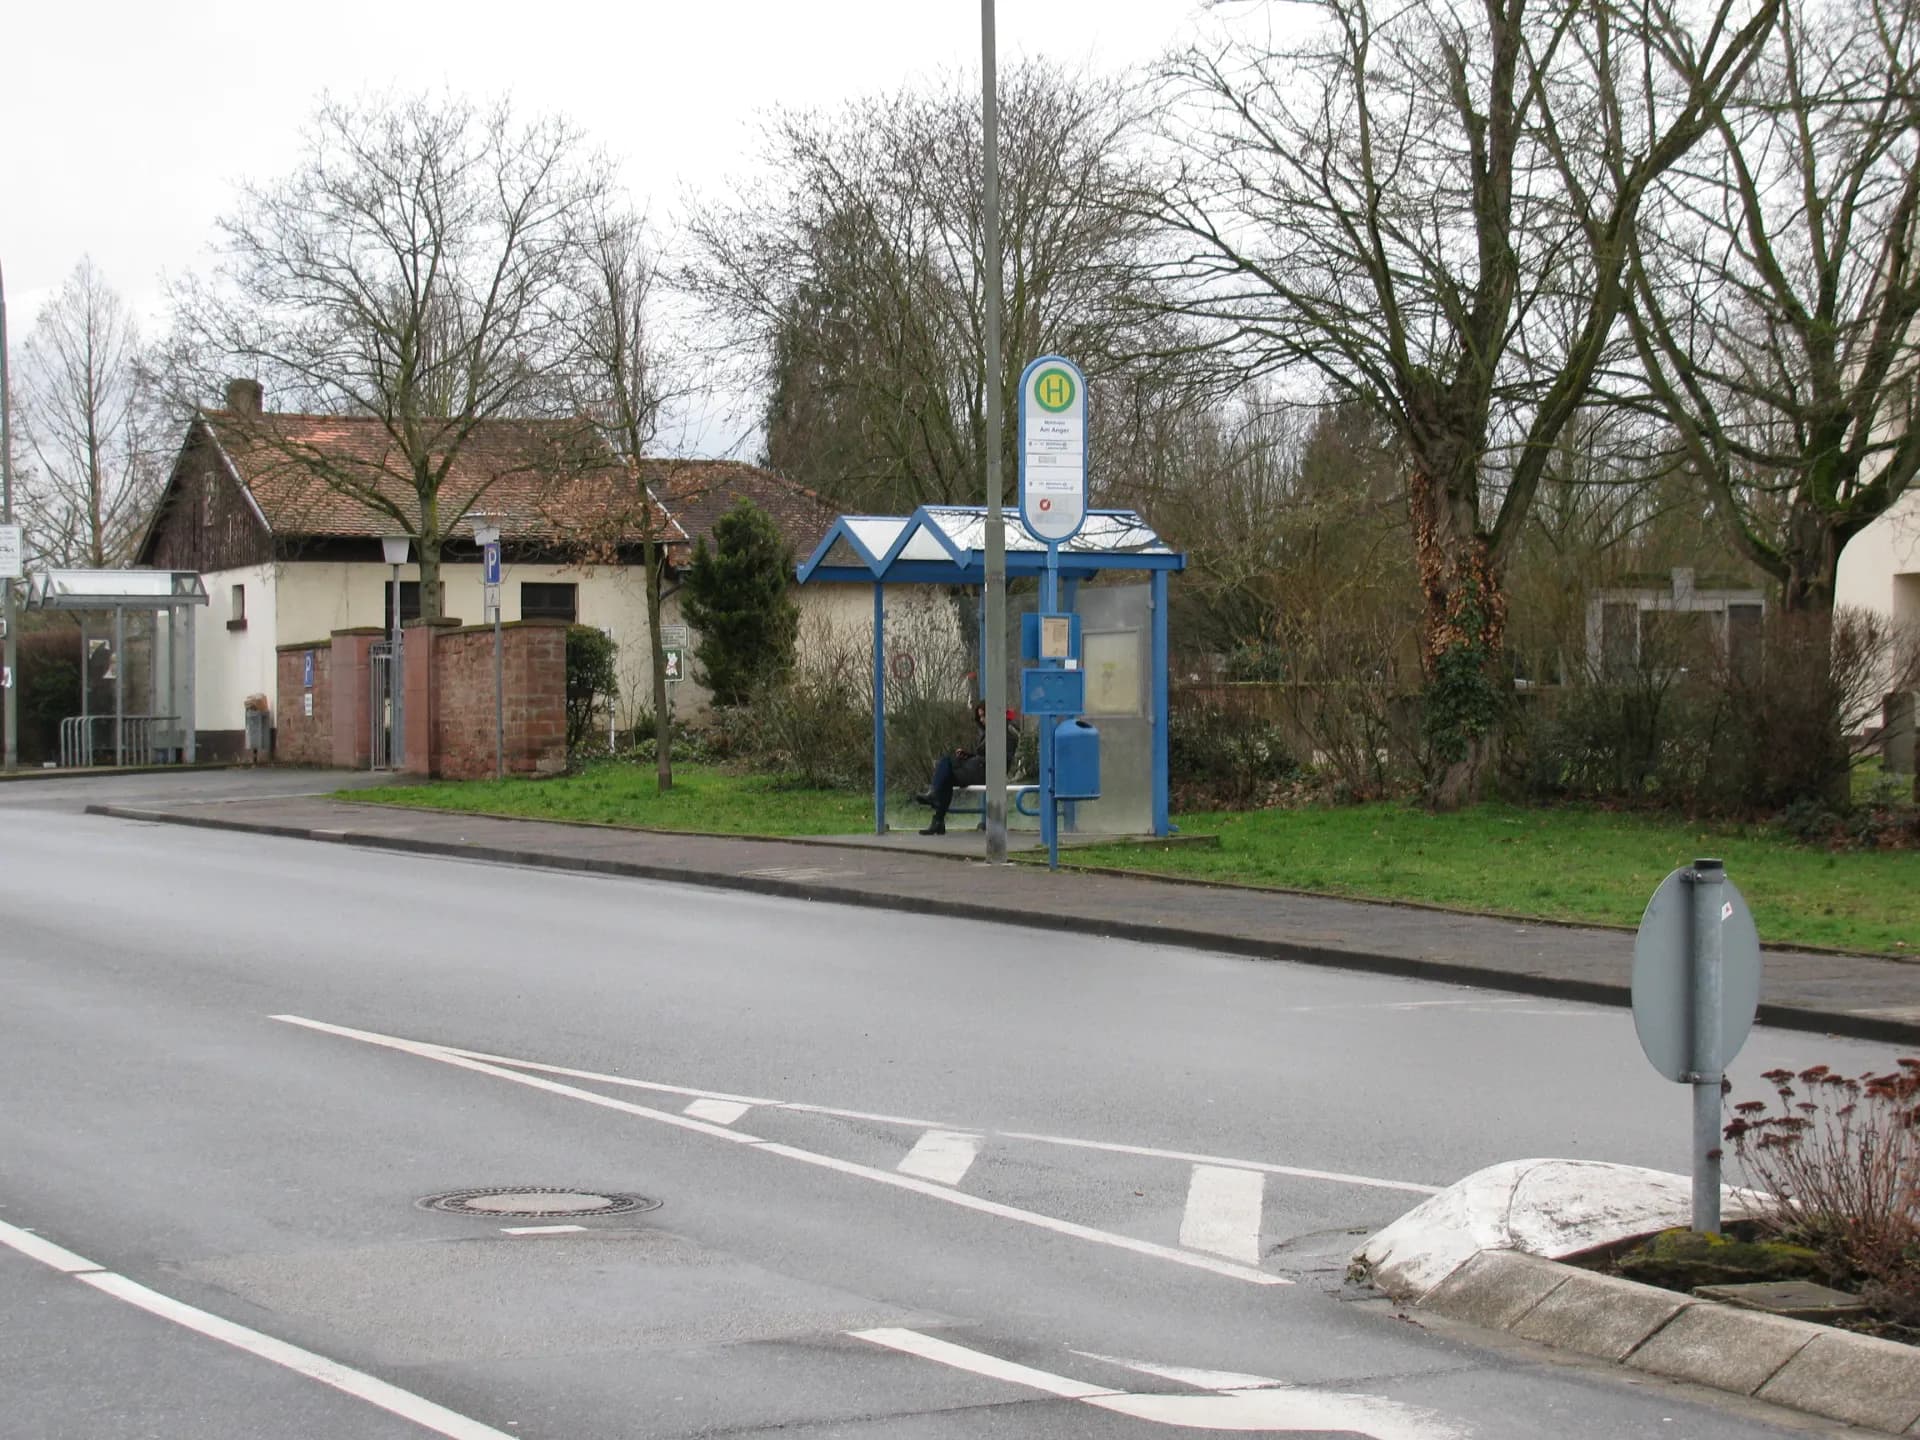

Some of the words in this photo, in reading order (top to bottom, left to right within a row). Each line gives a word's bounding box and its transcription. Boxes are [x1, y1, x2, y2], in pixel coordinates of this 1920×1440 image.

[1046, 378, 1063, 403] H
[488, 549, 497, 579] P
[305, 656, 312, 681] P
